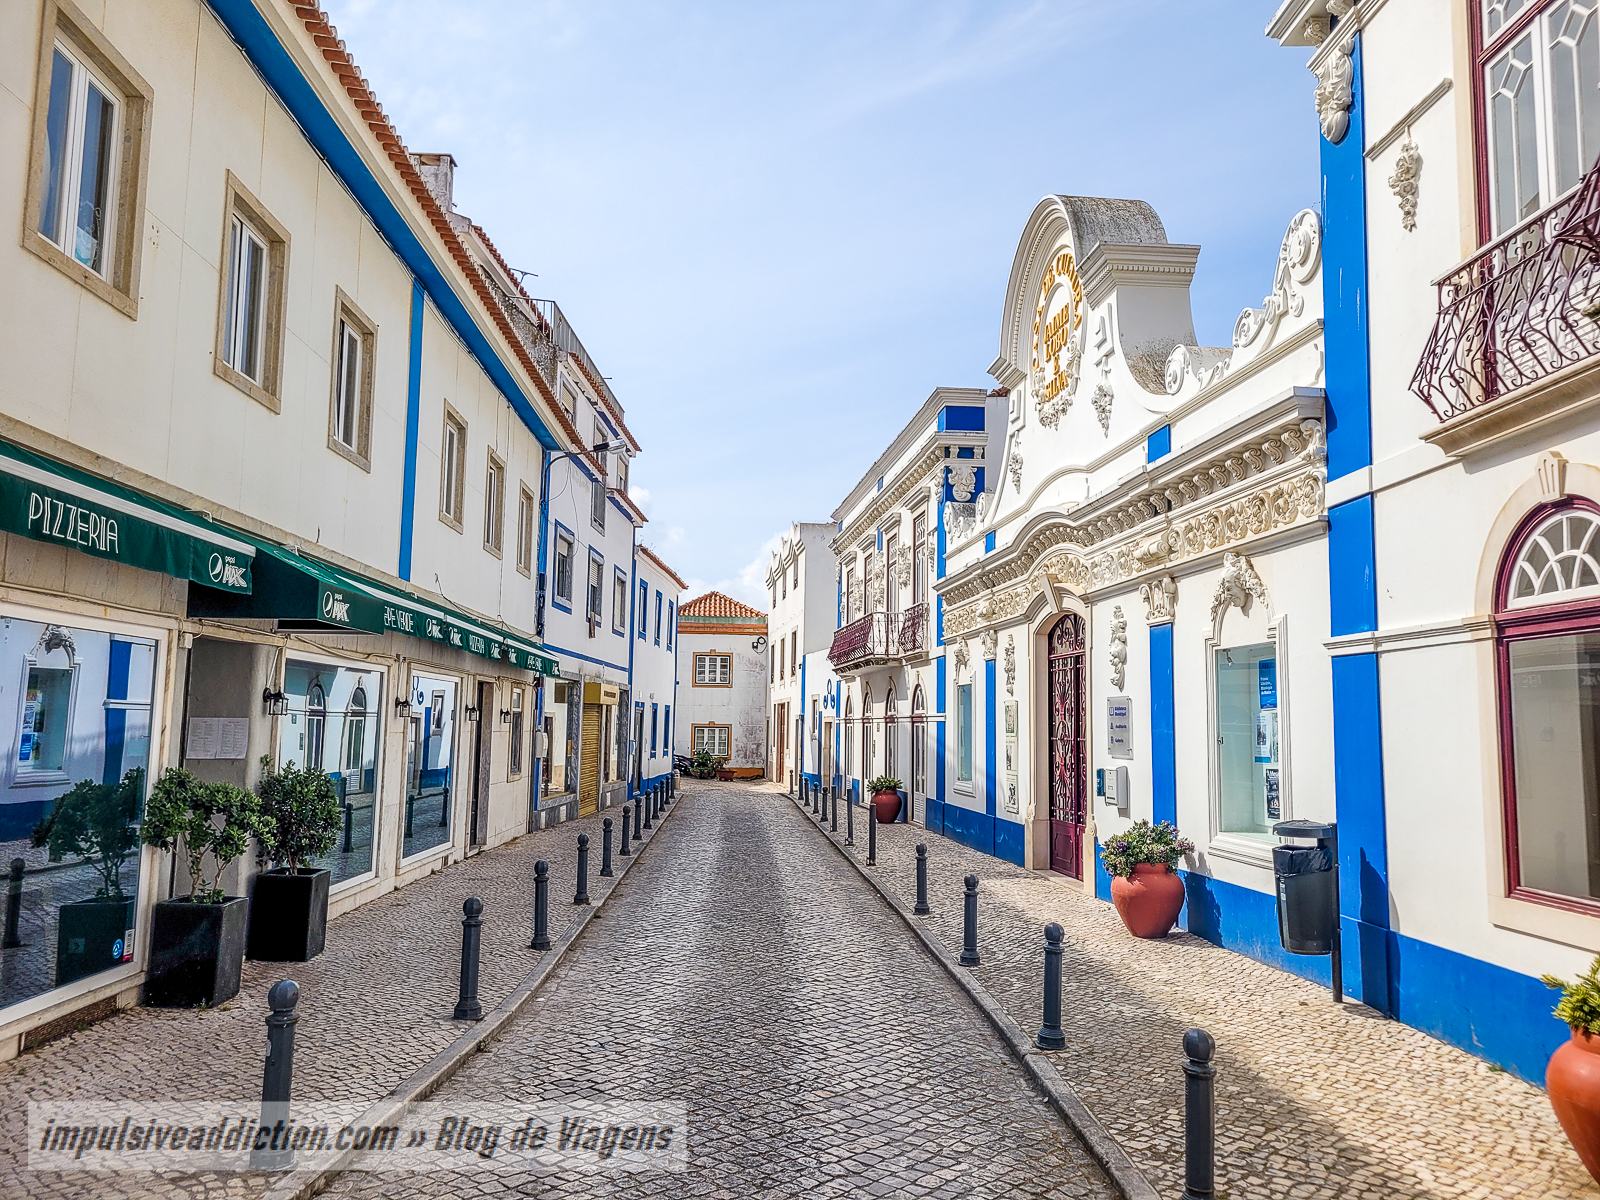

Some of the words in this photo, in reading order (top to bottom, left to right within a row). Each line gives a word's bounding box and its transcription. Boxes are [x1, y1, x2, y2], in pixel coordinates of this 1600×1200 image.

[1042, 265, 1056, 302] DE
[1045, 326, 1069, 363] LOBO
[28, 492, 119, 554] PIZZERIA
[222, 563, 248, 588] MAX
